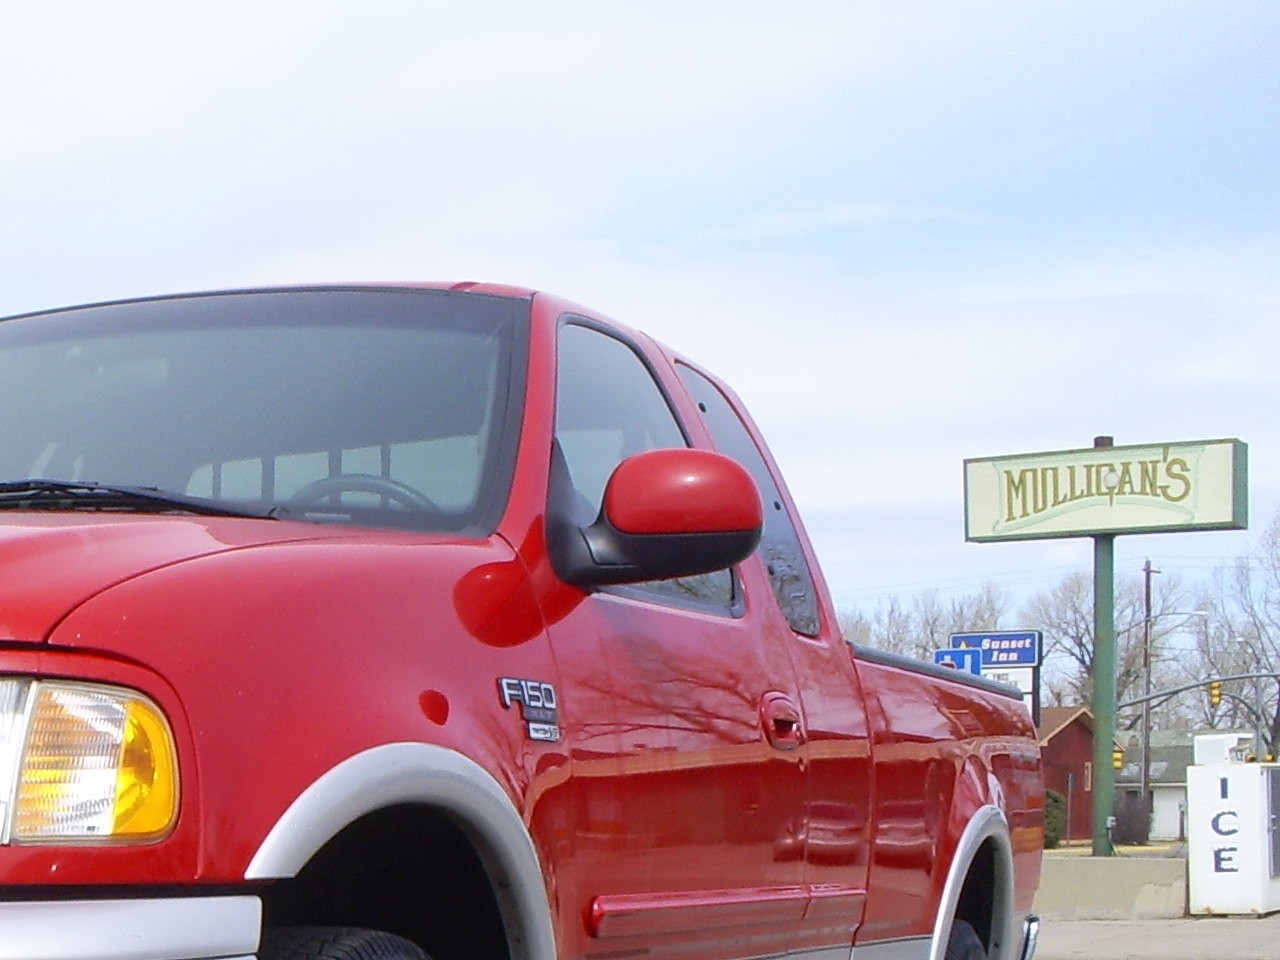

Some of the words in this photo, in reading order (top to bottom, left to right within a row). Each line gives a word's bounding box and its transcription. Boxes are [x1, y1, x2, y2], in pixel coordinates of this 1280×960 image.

[1003, 446, 1191, 522] MULLIGAN'S
[981, 638, 1037, 650] Sunset
[991, 651, 1019, 662] Inn
[1210, 776, 1240, 873] ICE
